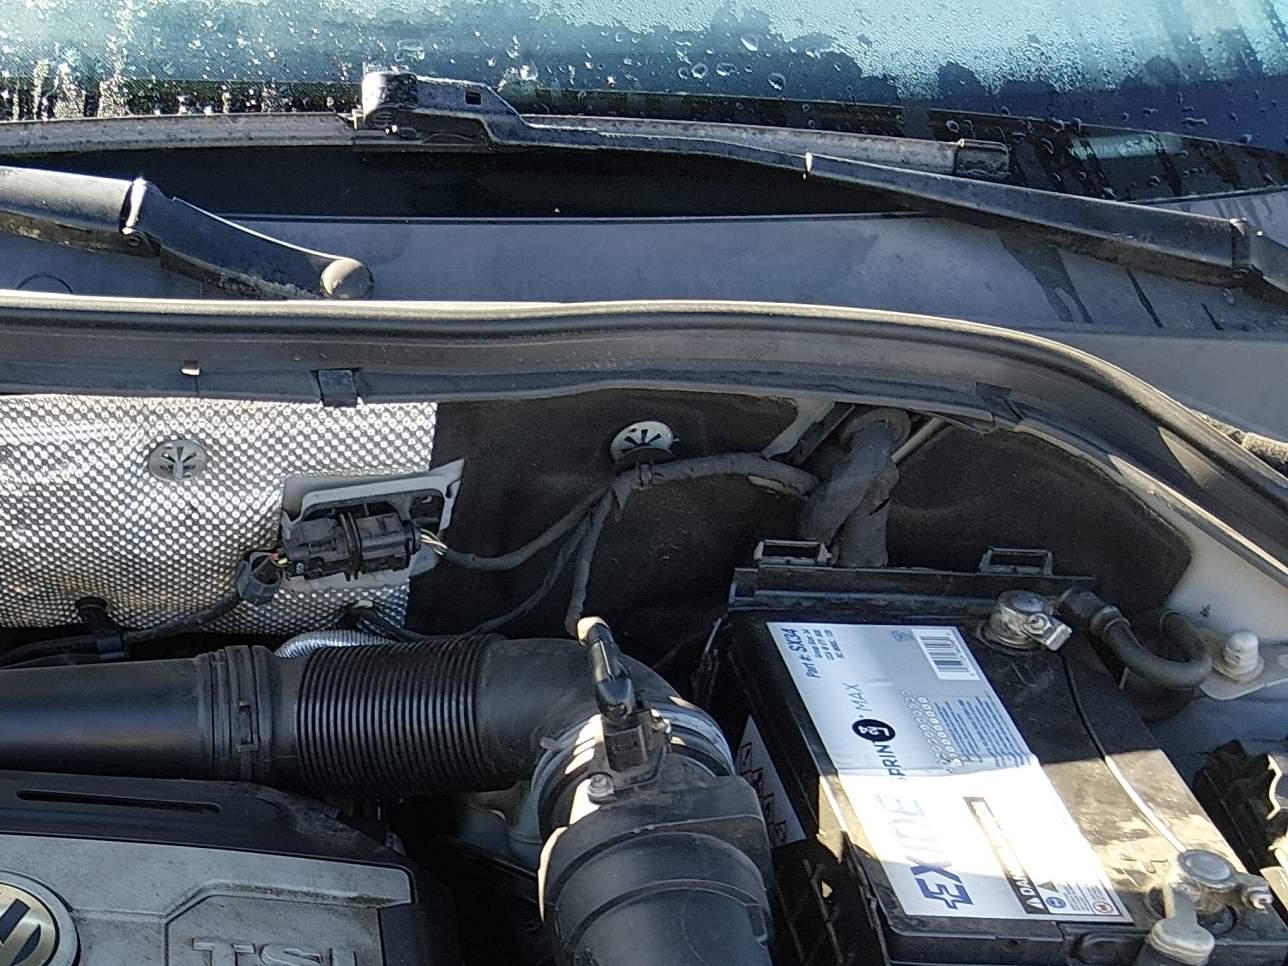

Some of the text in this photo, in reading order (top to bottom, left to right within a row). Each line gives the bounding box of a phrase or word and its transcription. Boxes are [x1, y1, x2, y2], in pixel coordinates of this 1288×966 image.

[781, 627, 808, 653] SX34
[841, 682, 872, 711] MAX
[856, 724, 891, 737] L24
